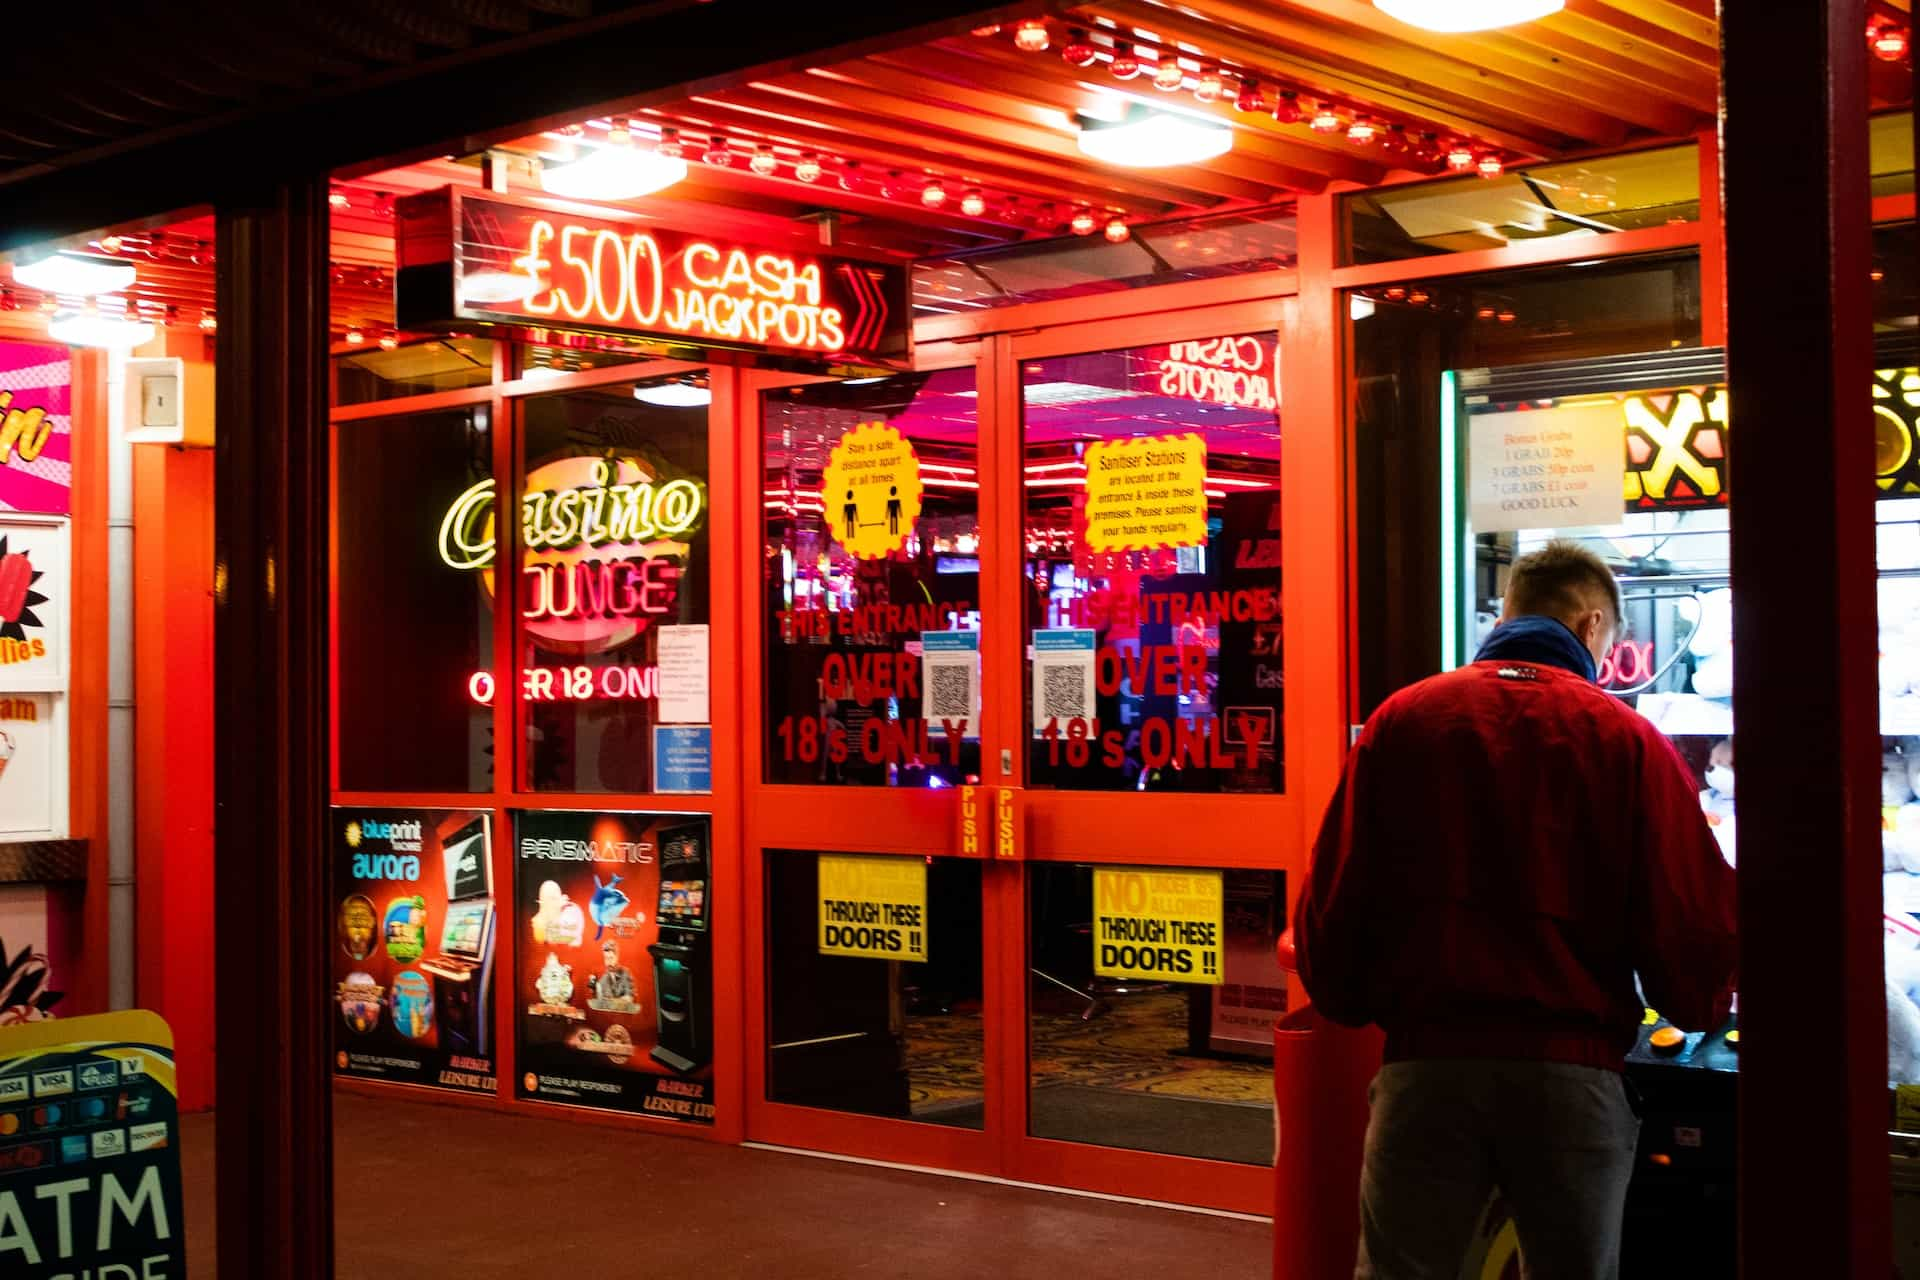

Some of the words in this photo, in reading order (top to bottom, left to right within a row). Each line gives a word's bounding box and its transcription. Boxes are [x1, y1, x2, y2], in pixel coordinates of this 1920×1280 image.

[514, 220, 662, 325] £500
[683, 243, 821, 304] CASH
[664, 288, 845, 349] JACKPOTS
[848, 443, 864, 455] Stay
[876, 440, 893, 450] safe
[1100, 455, 1142, 471] Sanitiser
[1146, 451, 1185, 467] Stations
[842, 459, 876, 471] distance
[880, 456, 901, 467] apart
[872, 472, 894, 484] times
[1502, 464, 1544, 477] GRABS
[1109, 477, 1121, 486] are
[1125, 474, 1153, 485] located
[1168, 472, 1180, 481] the
[1502, 480, 1544, 493] GRABS
[1098, 493, 1133, 503] entrance
[1136, 490, 1142, 500] &
[1145, 490, 1169, 499] inside
[1172, 488, 1194, 497] these
[1502, 498, 1540, 512] GOOD
[1542, 496, 1578, 509] LUCK
[1136, 507, 1162, 517] Please
[1165, 504, 1197, 514] sanitise
[1103, 527, 1120, 537] your
[1123, 525, 1147, 535] hands
[523, 558, 670, 618] OUNGE
[776, 610, 830, 638] THIS
[838, 601, 971, 634] ENTRANCE
[822, 651, 918, 699] OVER
[1096, 645, 1208, 697] OVER
[469, 671, 554, 706] OER
[561, 666, 594, 699] 18
[601, 666, 660, 699] ONL
[778, 715, 848, 764] 18's
[862, 718, 968, 767] ONLY
[1043, 716, 1124, 769] 18's
[1139, 716, 1269, 769] ONLY
[362, 818, 421, 844] blueprint
[962, 786, 977, 853] PUSH
[1000, 789, 1014, 856] PUSH
[521, 838, 654, 864] PRISMATIC
[352, 852, 420, 881] aurora
[1099, 872, 1147, 913] NO
[824, 899, 880, 924] THROUGH
[883, 903, 920, 927] THESE
[826, 925, 901, 951] DOORS
[909, 931, 920, 953] !!
[1100, 916, 1166, 944] THROUGH
[1170, 920, 1216, 946] THESE
[1102, 944, 1192, 973] DOORS
[1203, 951, 1216, 975] !!
[40, 1074, 67, 1087] VISA
[0, 1166, 171, 1265] ATM
